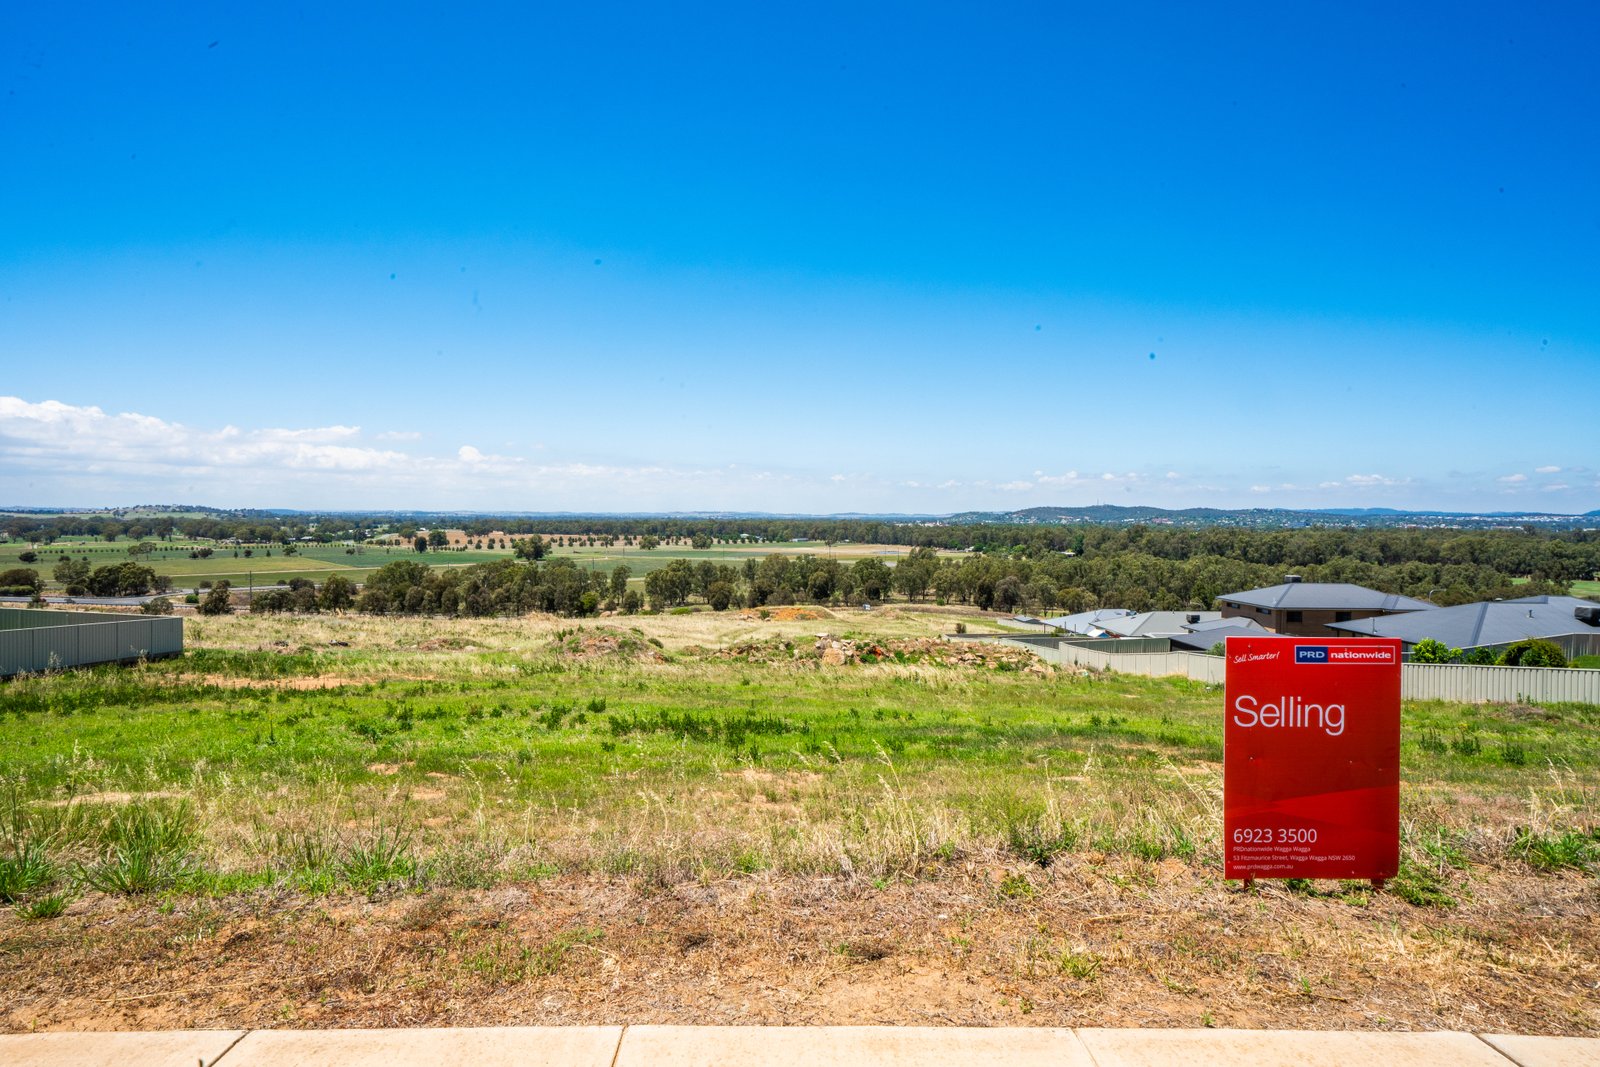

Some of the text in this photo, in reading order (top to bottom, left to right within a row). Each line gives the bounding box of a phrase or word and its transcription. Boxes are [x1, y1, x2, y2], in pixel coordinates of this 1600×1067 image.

[1233, 651, 1280, 664] Sell Smarter!
[1299, 650, 1392, 659] PRD nationwide
[1233, 695, 1345, 736] Selling
[1233, 828, 1318, 843] 6923 3500
